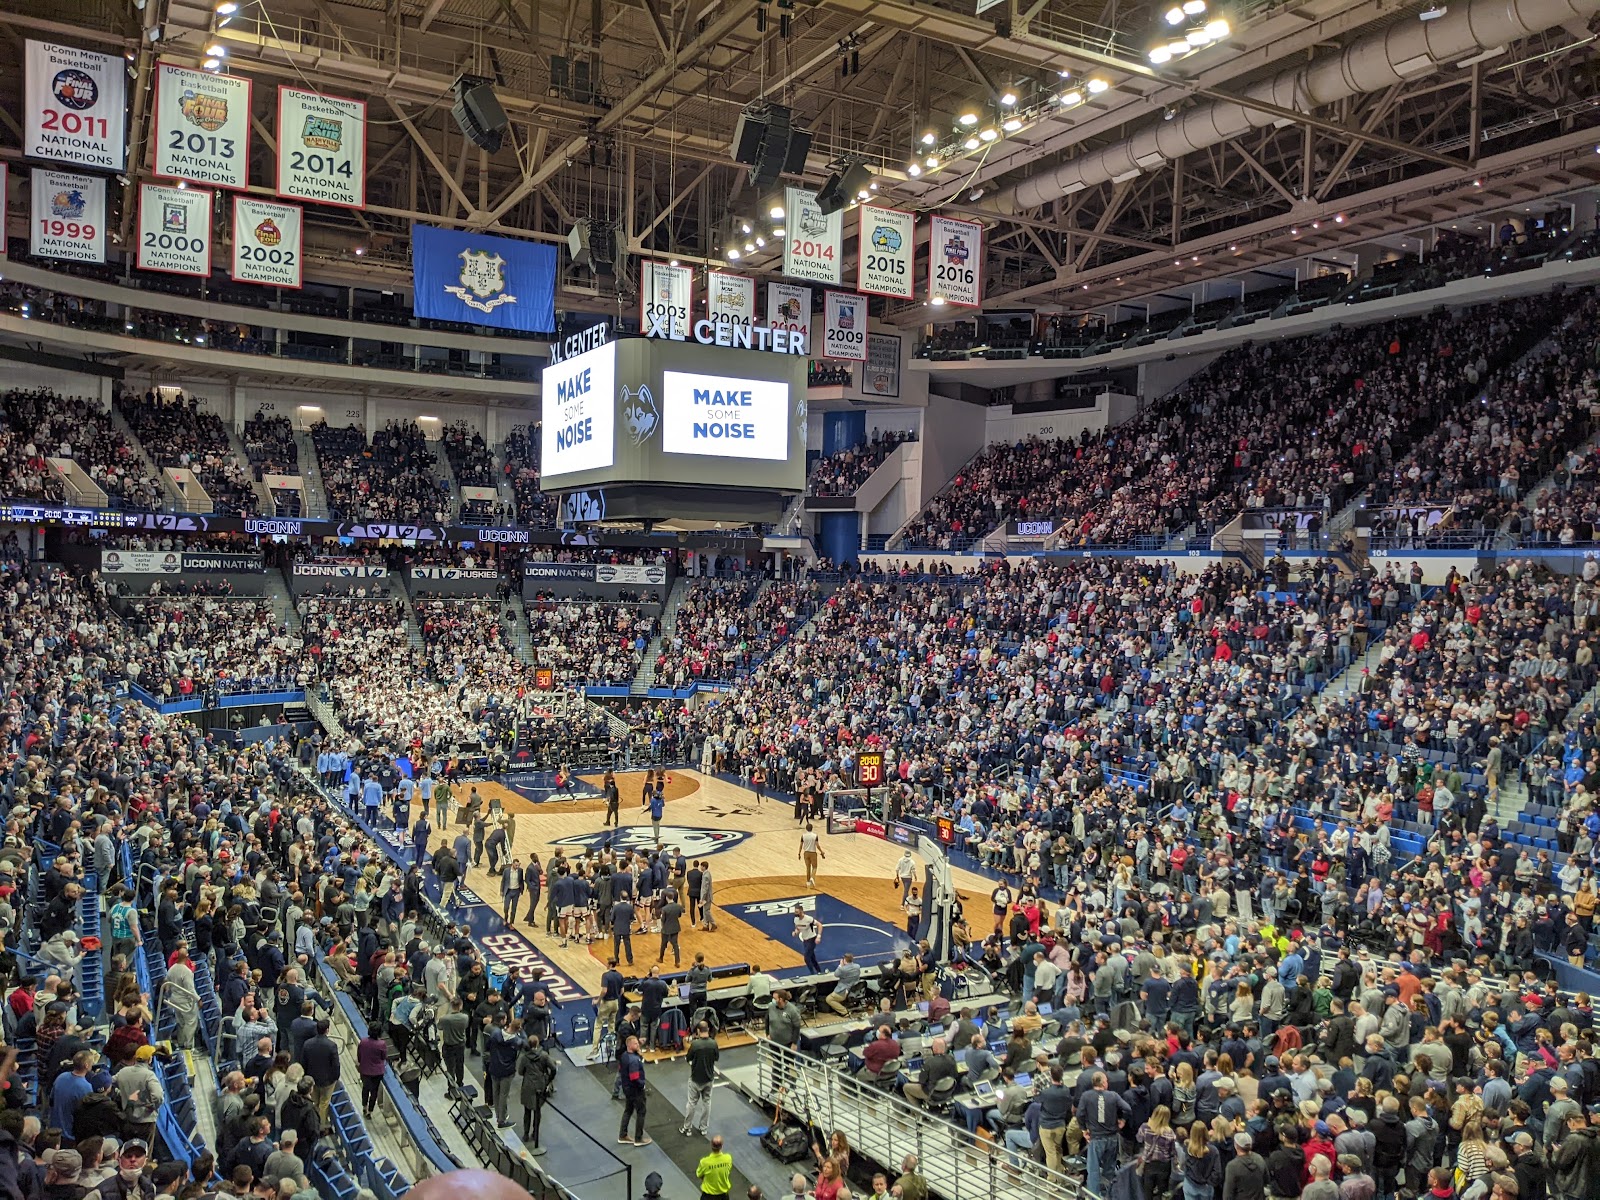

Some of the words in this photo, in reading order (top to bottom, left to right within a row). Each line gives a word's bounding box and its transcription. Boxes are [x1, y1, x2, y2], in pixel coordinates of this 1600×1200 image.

[44, 44, 77, 56] UConn
[80, 52, 108, 62] Men's
[50, 56, 101, 71] Basketball
[66, 77, 93, 90] FINAL
[167, 67, 197, 79] UConn
[200, 74, 241, 87] Women's
[181, 80, 227, 95] Basketball
[196, 94, 226, 108] FINAL
[288, 91, 317, 102] UConn
[320, 97, 357, 109] Women's
[183, 100, 226, 120] FOUR
[301, 103, 345, 116] Basketball
[41, 109, 107, 138] 2011
[42, 134, 108, 152] NATIONAL
[168, 130, 235, 158] 2013
[36, 146, 113, 165] CHAMPIONS
[171, 154, 231, 171] NATIONAL
[290, 151, 353, 178] 2014
[166, 165, 236, 184] CHAMPIONS
[50, 180, 88, 190] Basketball
[293, 174, 350, 190] NATIONAL
[147, 185, 170, 194] UConn
[172, 189, 204, 198] Women's
[288, 186, 354, 203] CHAMPIONS
[158, 195, 194, 205] Basketball
[252, 209, 286, 218] Basketball
[265, 204, 295, 213] Women's
[886, 211, 909, 219] Women's
[874, 216, 902, 225] Basketball
[955, 221, 978, 230] Women's
[41, 220, 96, 240] 1999
[256, 229, 276, 238] Final
[944, 227, 970, 236] Basketball
[43, 238, 93, 250] NATIONAL
[144, 232, 204, 253] 2000
[38, 248, 96, 260] CHAMPIONS
[151, 251, 197, 262] NATIONAL
[240, 245, 294, 266] 2002
[792, 239, 834, 261] 2014
[147, 260, 201, 272] CHAMPIONS
[245, 263, 289, 274] NATIONAL
[794, 259, 831, 271] NATIONAL
[866, 255, 905, 275] 2015
[241, 272, 293, 284] CHAMPIONS
[790, 268, 834, 280] CHAMPIONS
[868, 274, 903, 284] NATIONAL
[936, 265, 974, 284] 2016
[865, 282, 906, 294] CHAMPIONS
[938, 282, 971, 293] NATIONAL
[935, 292, 974, 303] CHAMPIONS
[646, 302, 686, 319] 2003
[711, 312, 750, 325] 2004
[646, 313, 685, 341] XL
[694, 319, 804, 355] CENTER
[828, 329, 863, 344] 2009
[550, 342, 562, 365] XL
[565, 322, 605, 358] CENTER
[558, 368, 590, 405] MAKE
[693, 389, 752, 406] MAKE
[260, 403, 275, 411] 224
[565, 401, 584, 421] SOME
[708, 410, 740, 420] SOME
[557, 417, 592, 453] NOISE
[693, 423, 755, 438] NOISE
[1040, 427, 1054, 435] 200
[245, 520, 300, 534] UCONN
[1018, 522, 1052, 534] UCONN
[479, 530, 528, 542] UCONN
[184, 559, 221, 568] UCONN
[293, 566, 335, 576] UCONN
[459, 570, 498, 579] HUSKIES
[526, 568, 557, 577] UCONN
[539, 677, 549, 686] 30
[860, 756, 879, 766] 20:00
[863, 766, 877, 781] 30
[942, 828, 949, 839] 30
[482, 934, 582, 1002] HUSKIES
